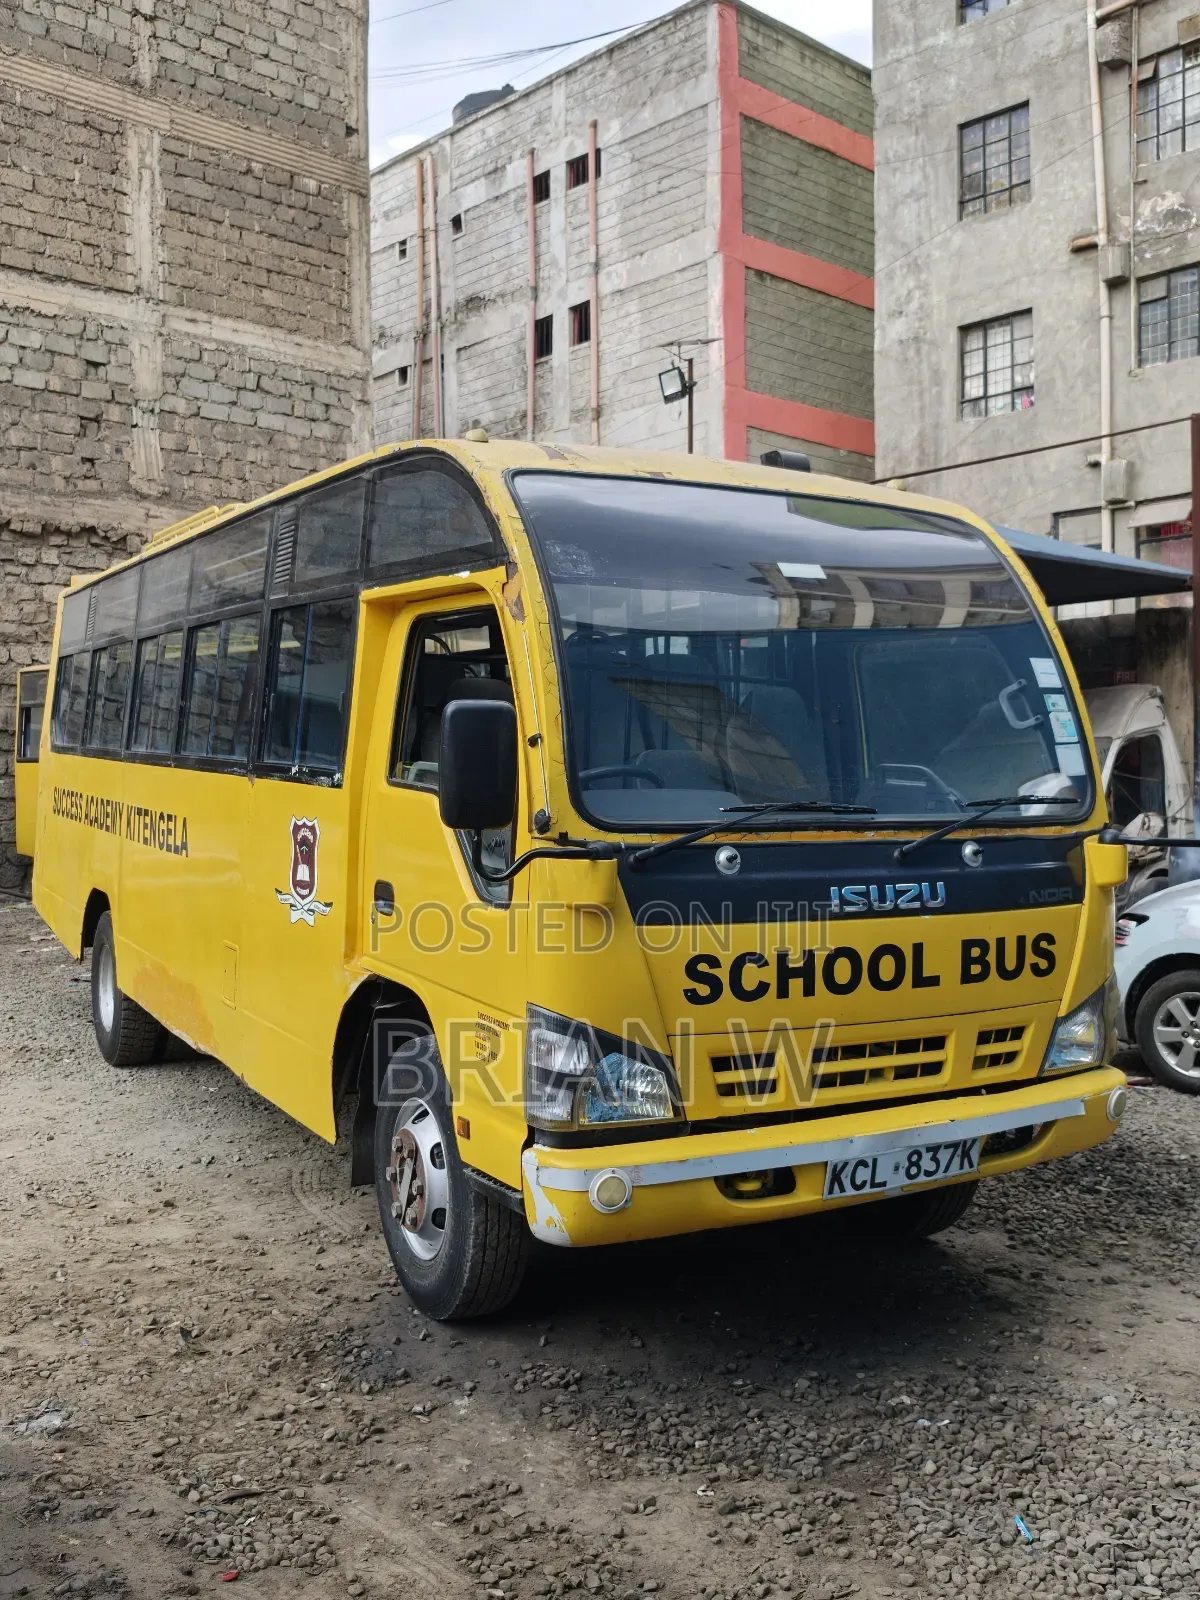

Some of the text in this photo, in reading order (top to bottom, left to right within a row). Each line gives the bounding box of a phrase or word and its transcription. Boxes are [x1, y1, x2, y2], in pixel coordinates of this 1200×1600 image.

[53, 786, 189, 858] SUCCESS ACADEMY KITENGELA
[830, 881, 946, 913] ISUZU
[683, 932, 1057, 1006] SCHOOL BUS
[827, 1138, 979, 1195] KCL 837K
